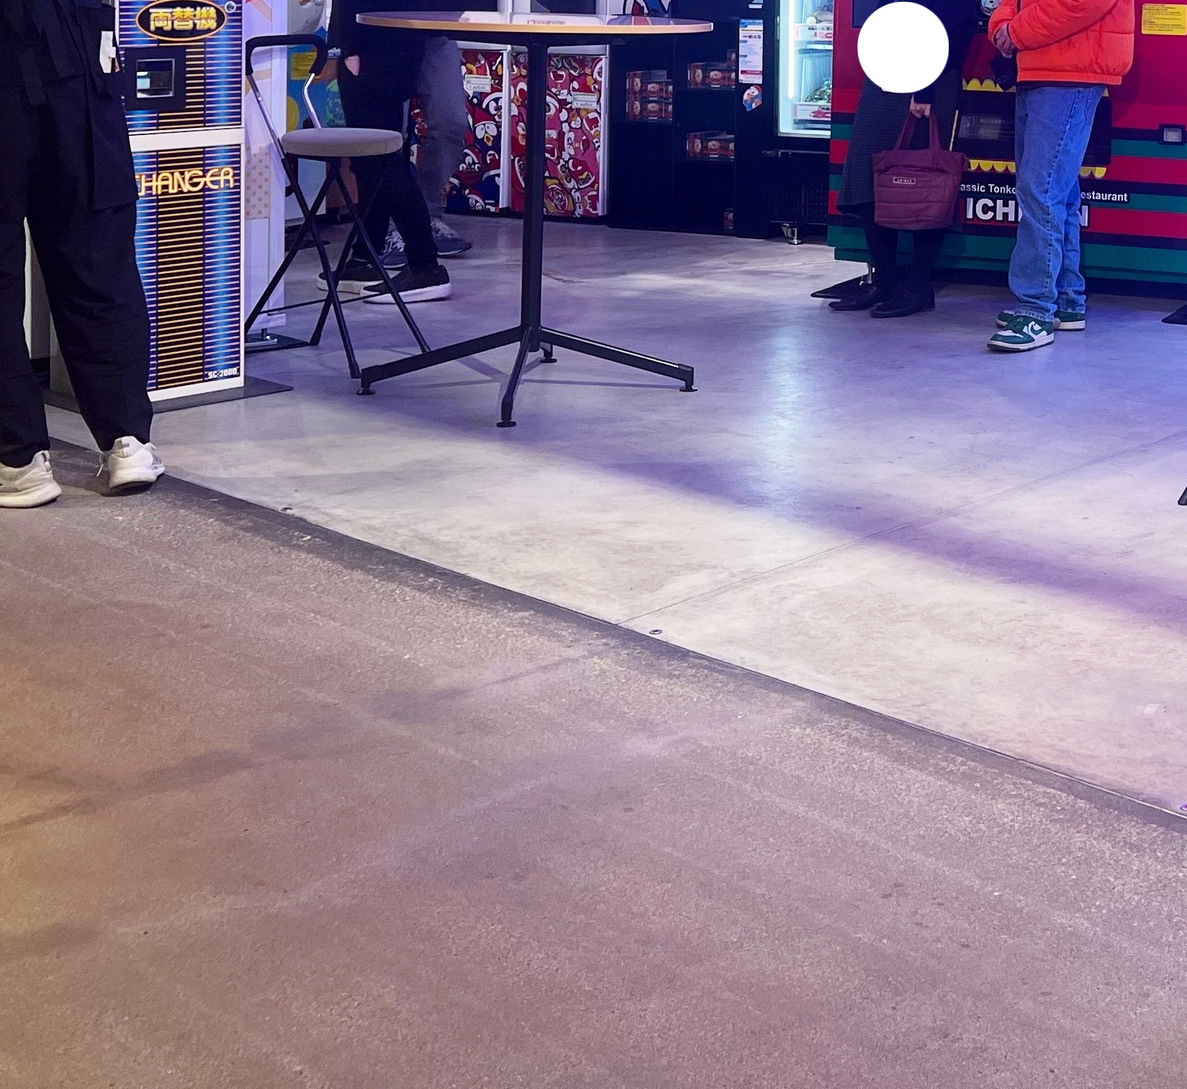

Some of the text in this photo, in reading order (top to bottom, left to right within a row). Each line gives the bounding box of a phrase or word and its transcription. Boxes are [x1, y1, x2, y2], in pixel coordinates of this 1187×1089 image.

[149, 6, 218, 31] 両替機
[960, 183, 1128, 202] assic Tonko estaurant
